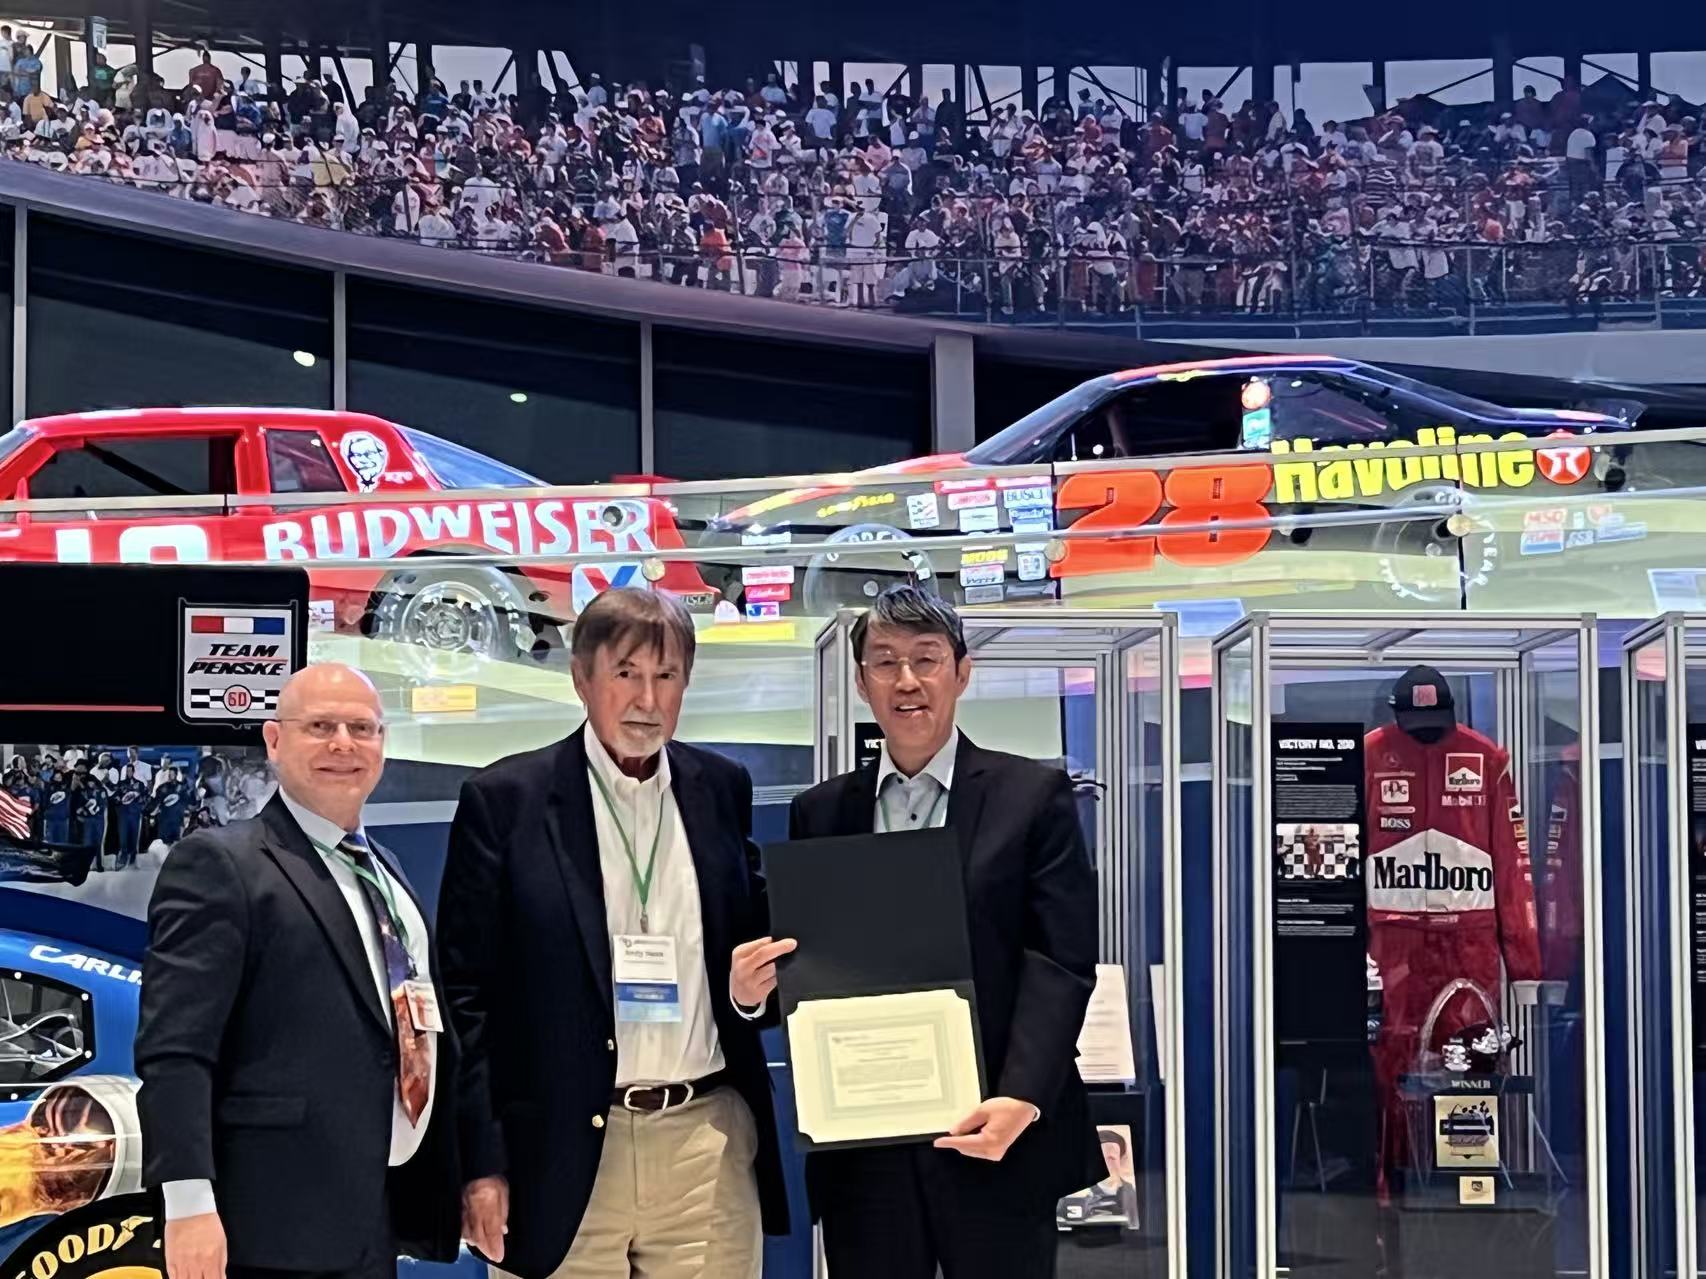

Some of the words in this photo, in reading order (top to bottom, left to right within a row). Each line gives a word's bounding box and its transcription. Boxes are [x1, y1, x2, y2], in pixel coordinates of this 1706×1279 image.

[1271, 427, 1534, 503] Havoline
[1049, 463, 1273, 578] 28
[263, 500, 656, 560] BUDWEISER
[209, 643, 279, 657] TEAM
[187, 661, 287, 675] PENSKE
[1449, 773, 1481, 786] Marlboro
[1380, 817, 1411, 829] BOSS
[1373, 851, 1493, 892] Marlboro
[1451, 1079, 1491, 1089] WINNER
[1066, 1205, 1083, 1219] 3
